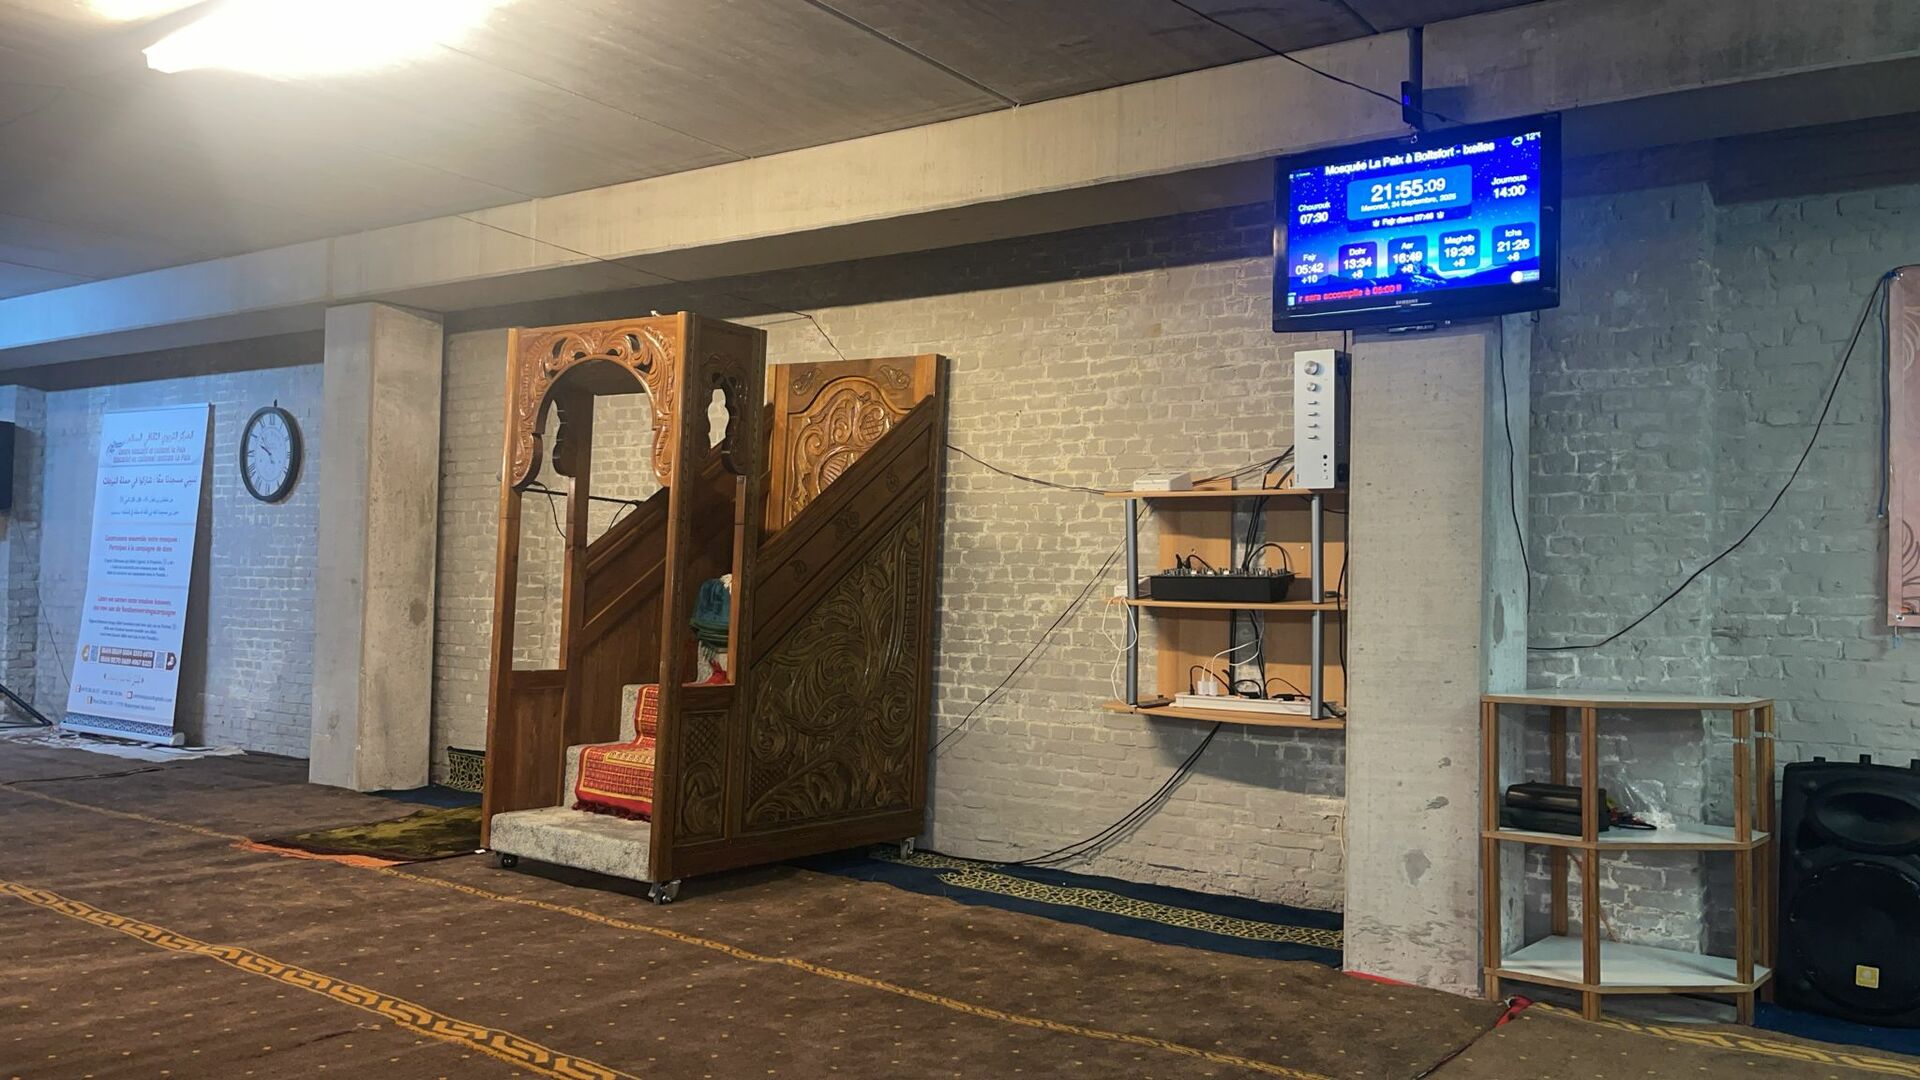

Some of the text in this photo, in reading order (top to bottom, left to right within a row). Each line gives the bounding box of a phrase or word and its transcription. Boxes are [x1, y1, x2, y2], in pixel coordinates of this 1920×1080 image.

[1325, 160, 1367, 175] Mosquée
[1368, 159, 1381, 170] La
[1383, 154, 1404, 167] Paix
[1405, 151, 1413, 163] à
[1414, 147, 1454, 162] Boitsfort
[1463, 141, 1495, 155] Ixelles
[1491, 174, 1527, 185] Joumoua
[1371, 177, 1446, 202] 21:55:09
[1493, 184, 1526, 199] 14:00
[1298, 201, 1331, 212] Chourouk
[1299, 211, 1329, 225] 07:30
[1444, 234, 1475, 245] Maghrib
[1349, 247, 1367, 256] Dohr
[1303, 253, 1317, 263] Fajr
[1343, 257, 1372, 269] 13:34
[1295, 262, 1324, 275] 05:42
[1301, 274, 1318, 284] +10
